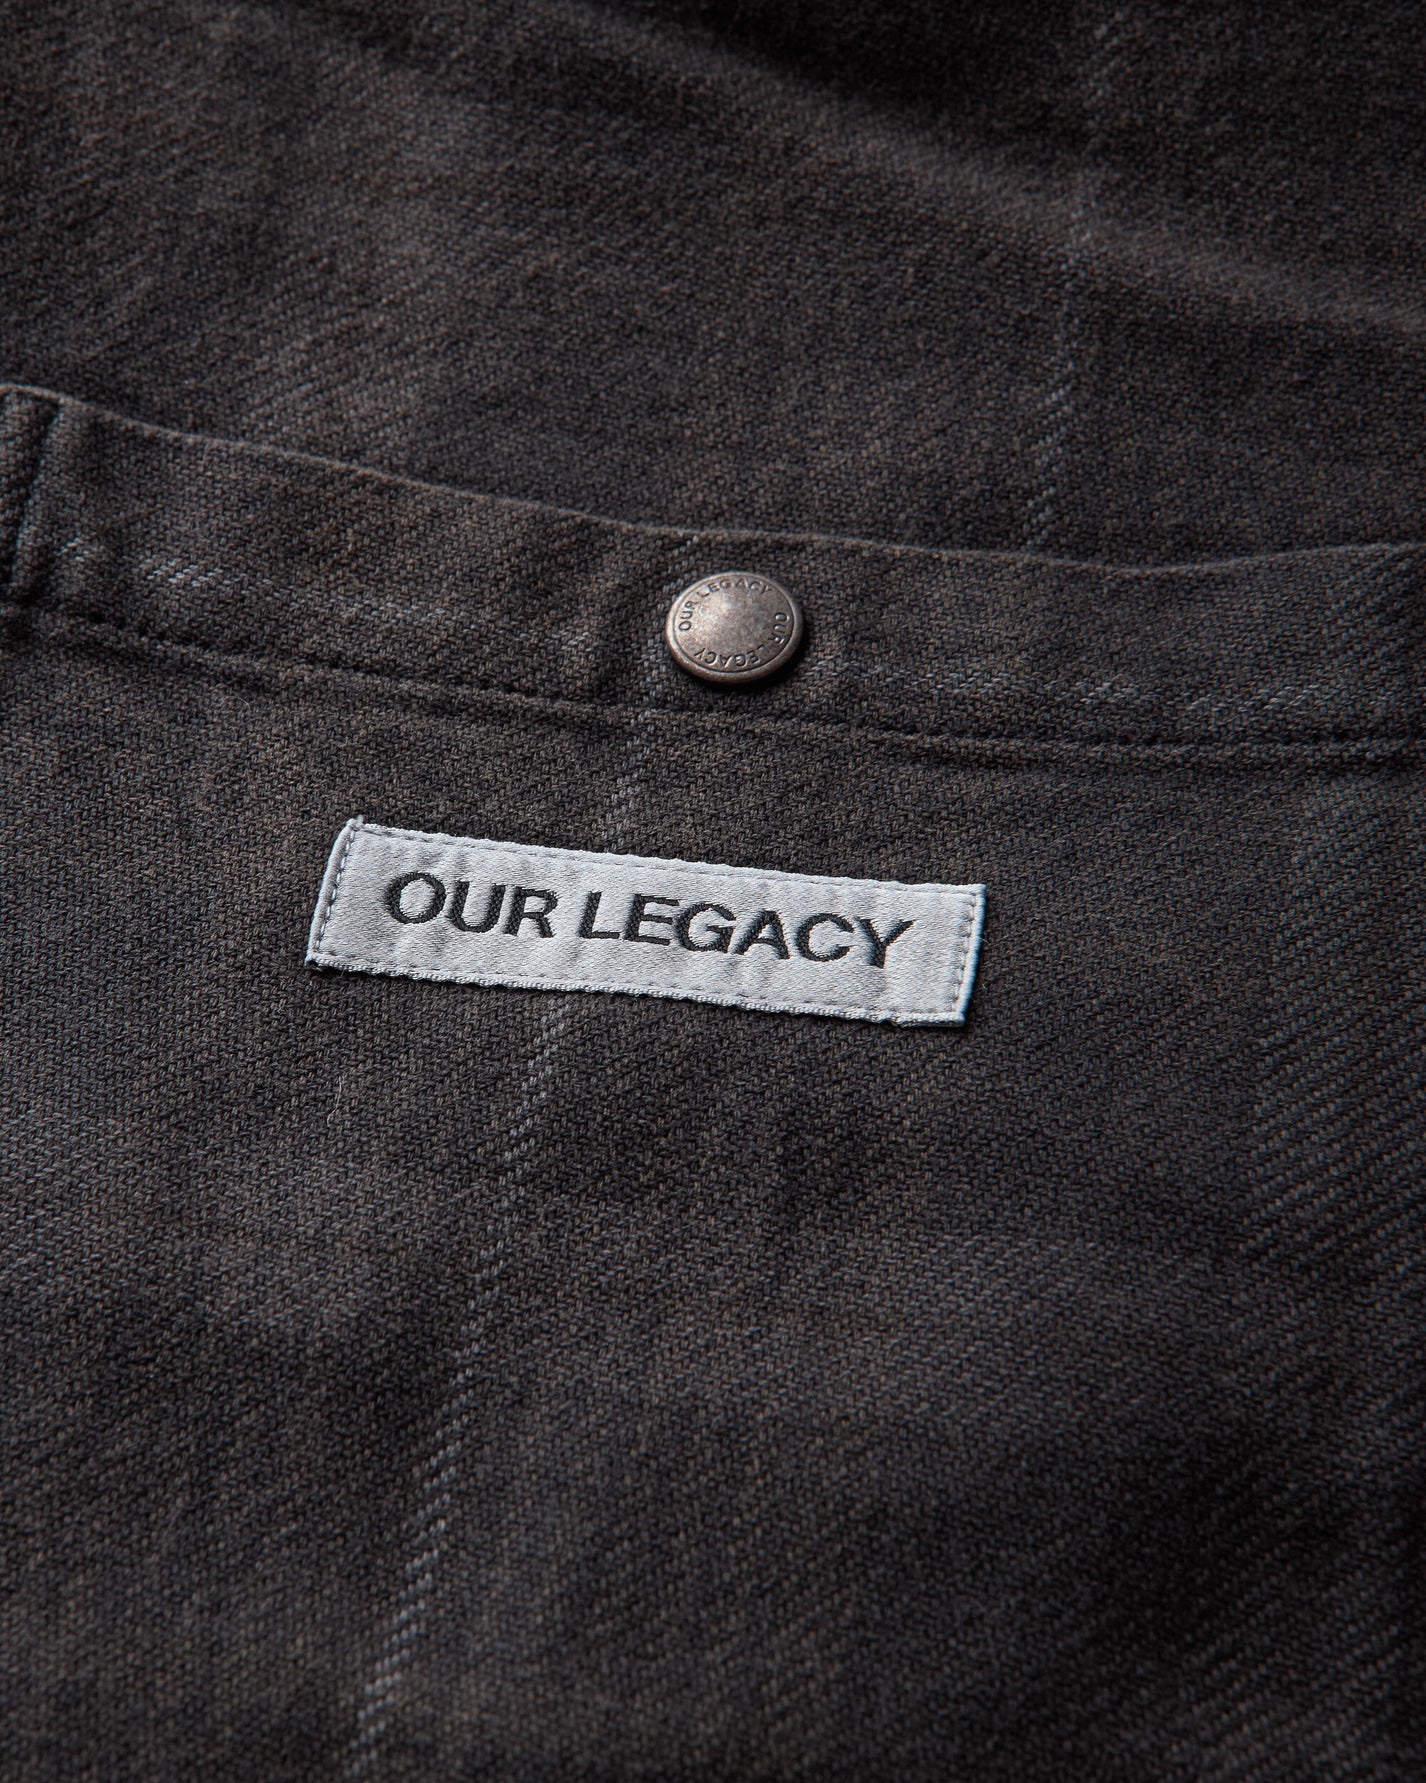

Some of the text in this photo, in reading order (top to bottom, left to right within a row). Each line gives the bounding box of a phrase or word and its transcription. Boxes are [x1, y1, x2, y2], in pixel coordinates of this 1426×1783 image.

[678, 578, 773, 631] OUR LEGACY
[694, 612, 790, 667] OUR LEGACY
[389, 871, 916, 968] OUR LEGACY
